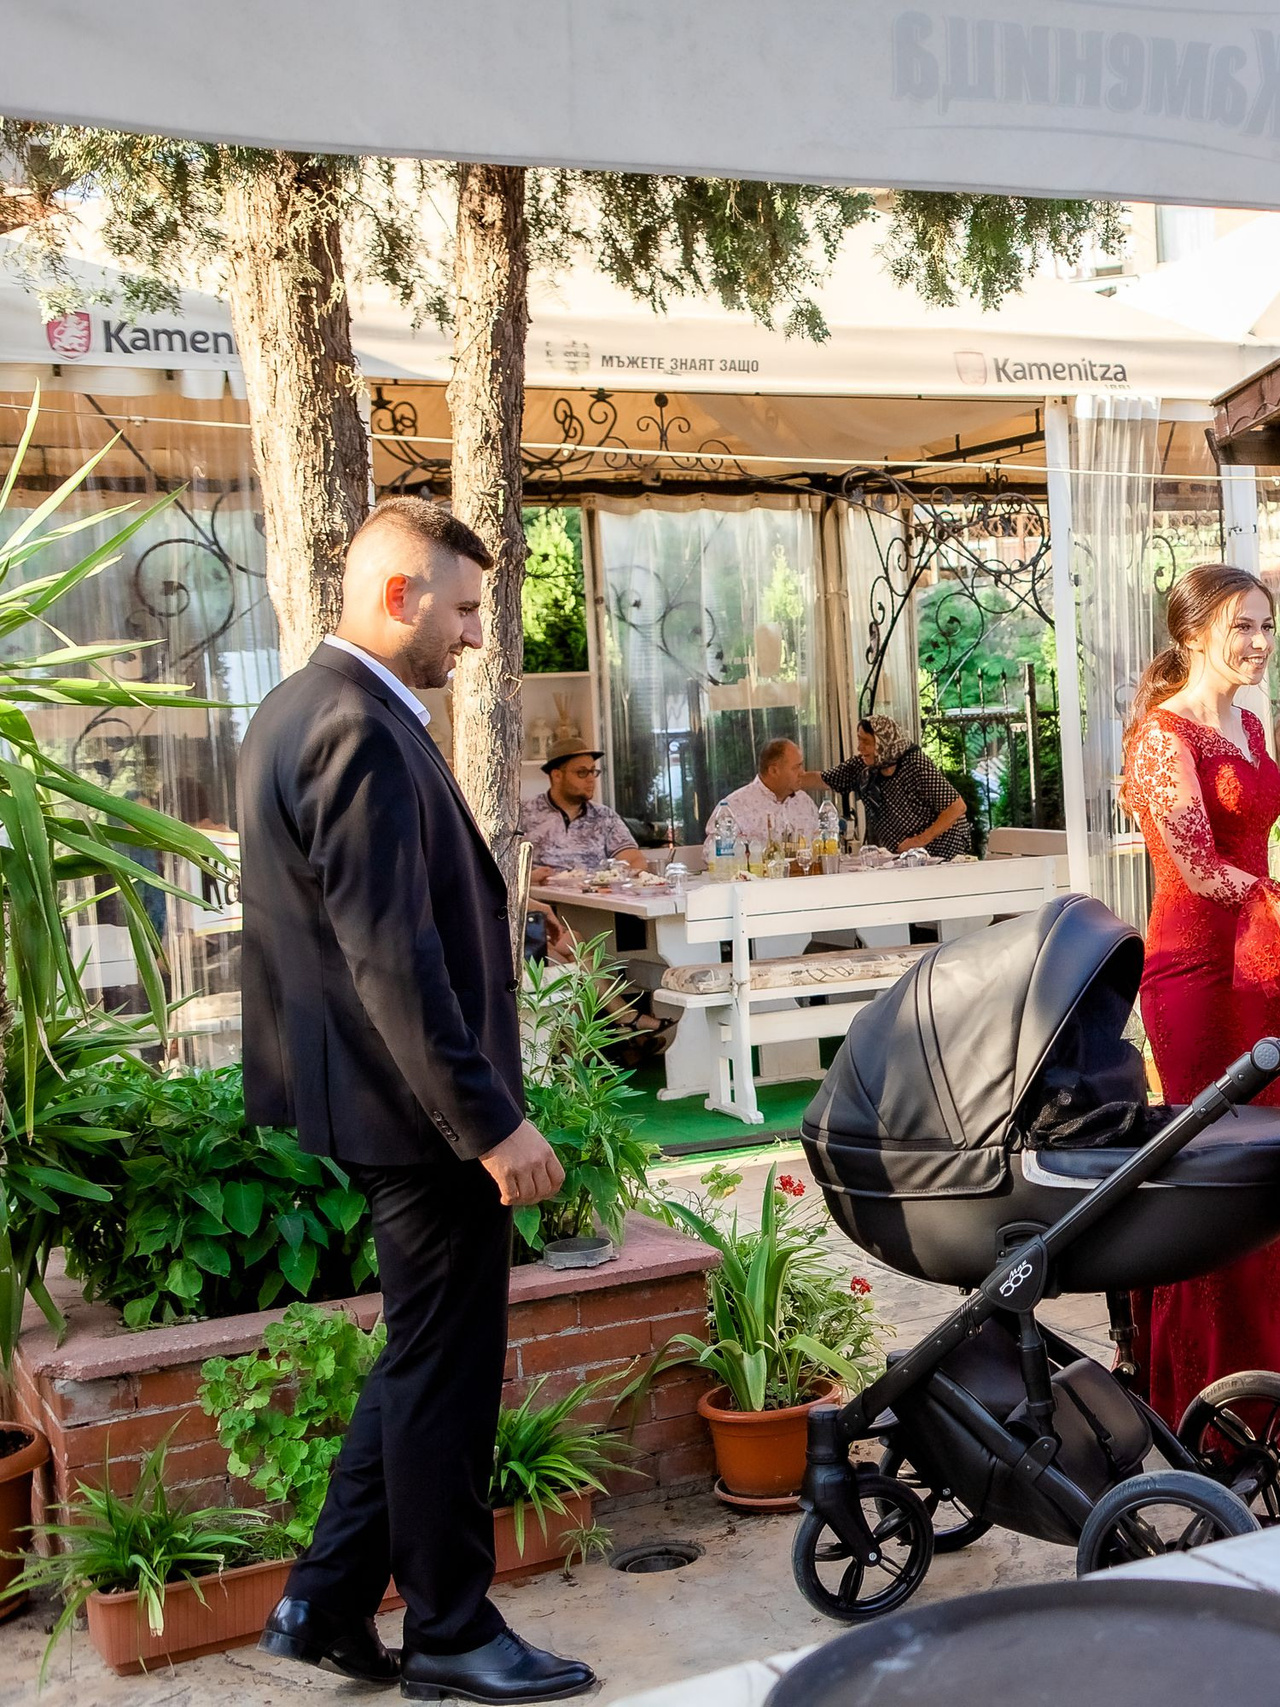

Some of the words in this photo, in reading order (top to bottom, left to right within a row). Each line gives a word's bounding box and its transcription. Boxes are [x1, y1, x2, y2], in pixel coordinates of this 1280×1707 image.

[601, 355, 665, 370] МЪЖЕТЕ
[670, 357, 715, 371] ЗНАЯТ
[720, 359, 760, 374] ЗАЩО
[993, 357, 1128, 383] Kamenitza
[999, 1264, 1033, 1297] 500
